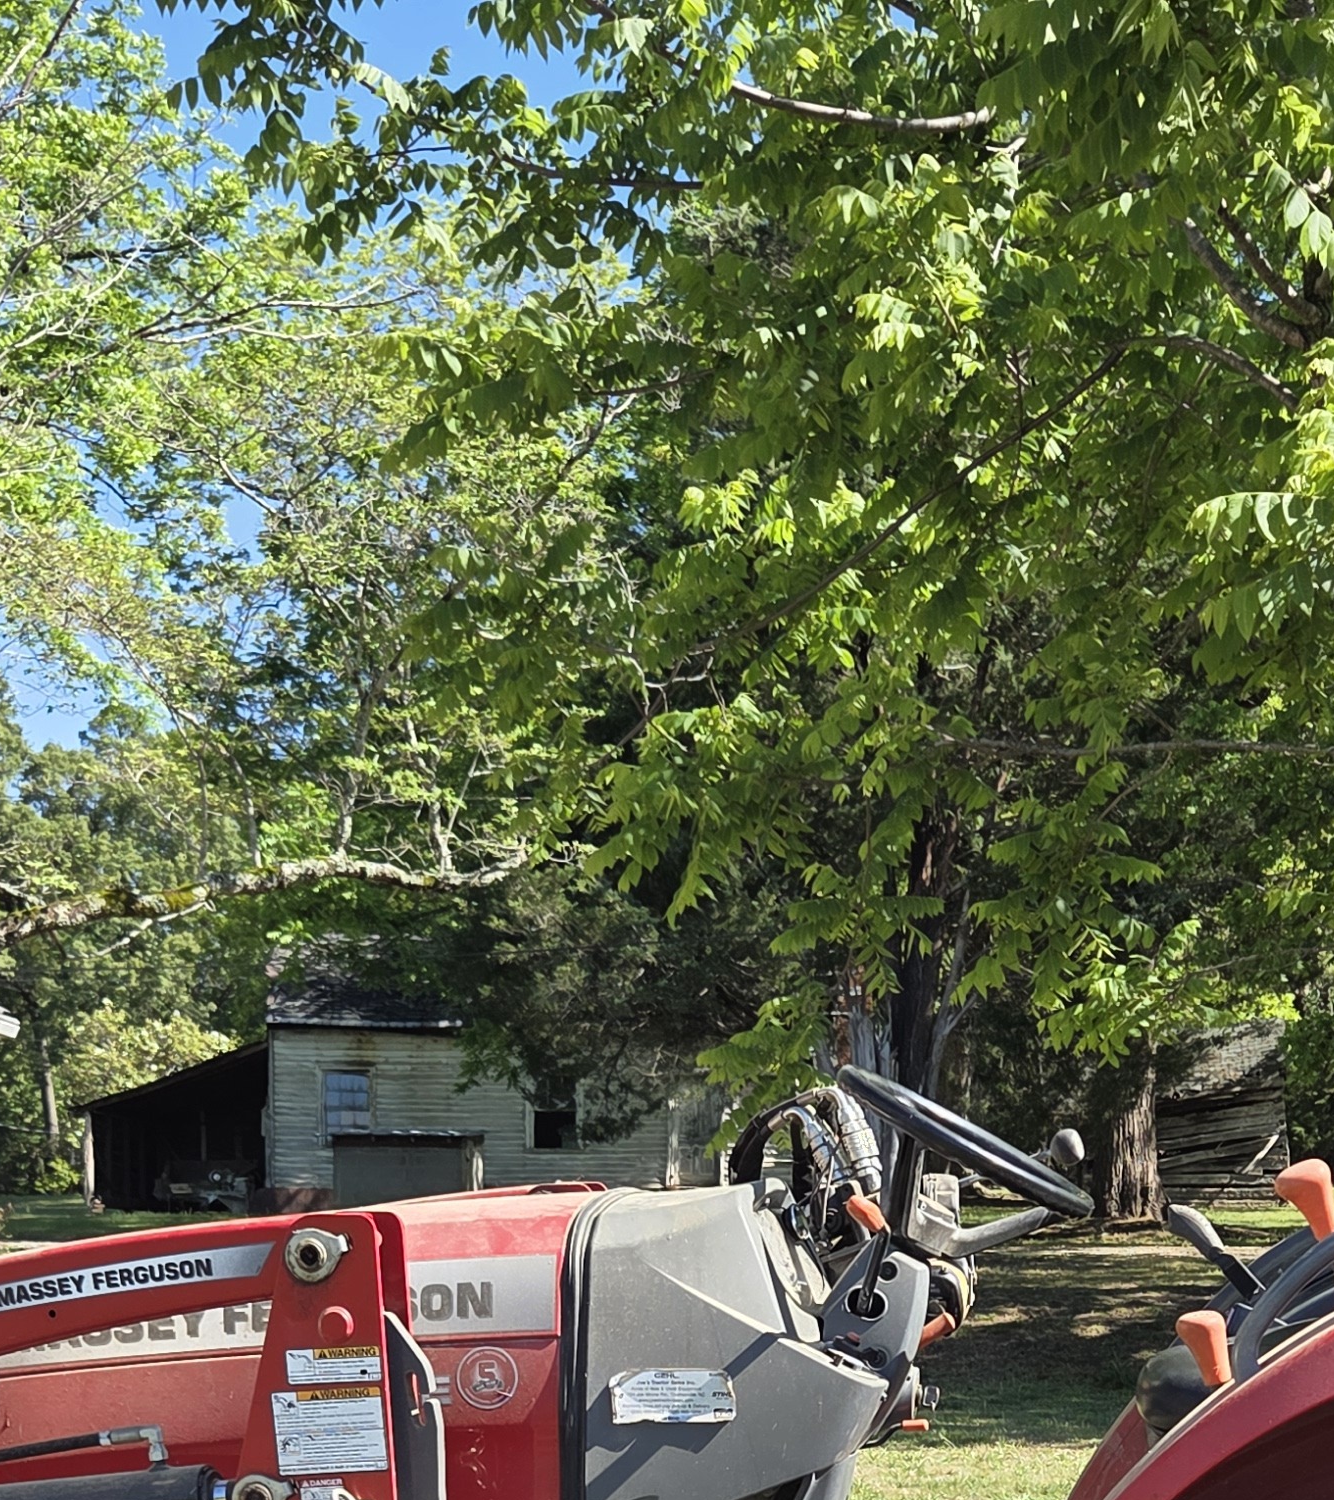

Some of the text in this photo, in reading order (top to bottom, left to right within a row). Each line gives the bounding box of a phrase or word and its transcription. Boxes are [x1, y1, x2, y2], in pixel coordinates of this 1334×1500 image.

[92, 1258, 214, 1290] FERGUSON
[328, 1347, 376, 1358] WARNING
[478, 1360, 496, 1381] 5
[319, 1388, 370, 1400] WARNING
[310, 1478, 343, 1487] DANGER
